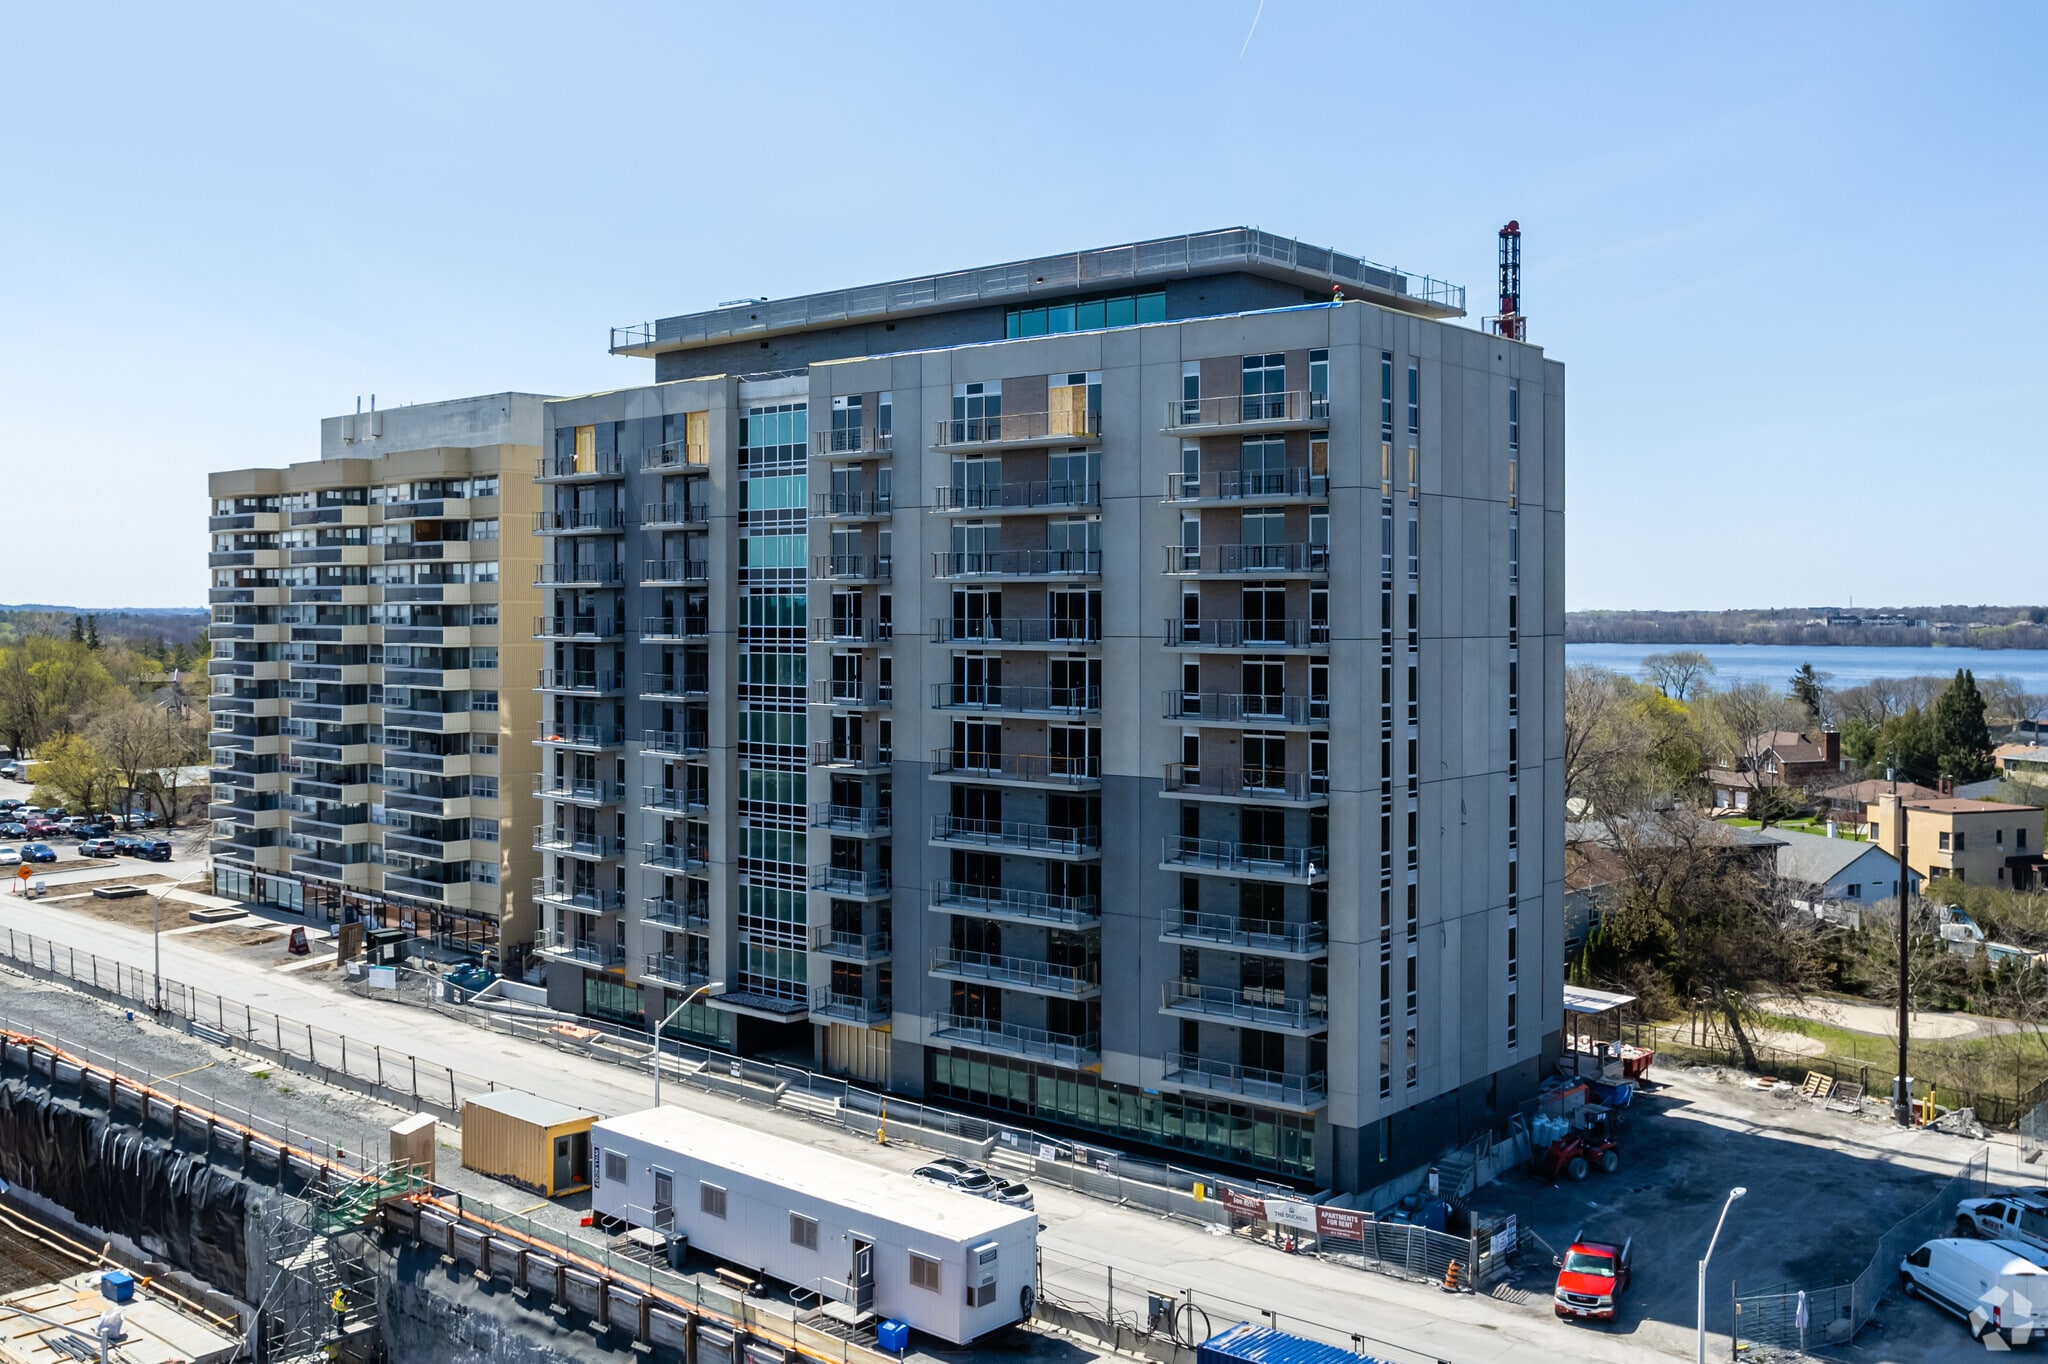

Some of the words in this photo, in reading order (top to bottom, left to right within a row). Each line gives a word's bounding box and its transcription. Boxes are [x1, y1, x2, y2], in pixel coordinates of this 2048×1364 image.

[1274, 1211, 1285, 1219] THE
[1285, 1213, 1308, 1222] DUCHESS
[1320, 1211, 1358, 1223] APARTMENTS
[1326, 1219, 1338, 1227] FOR
[1338, 1220, 1353, 1229] RENT
